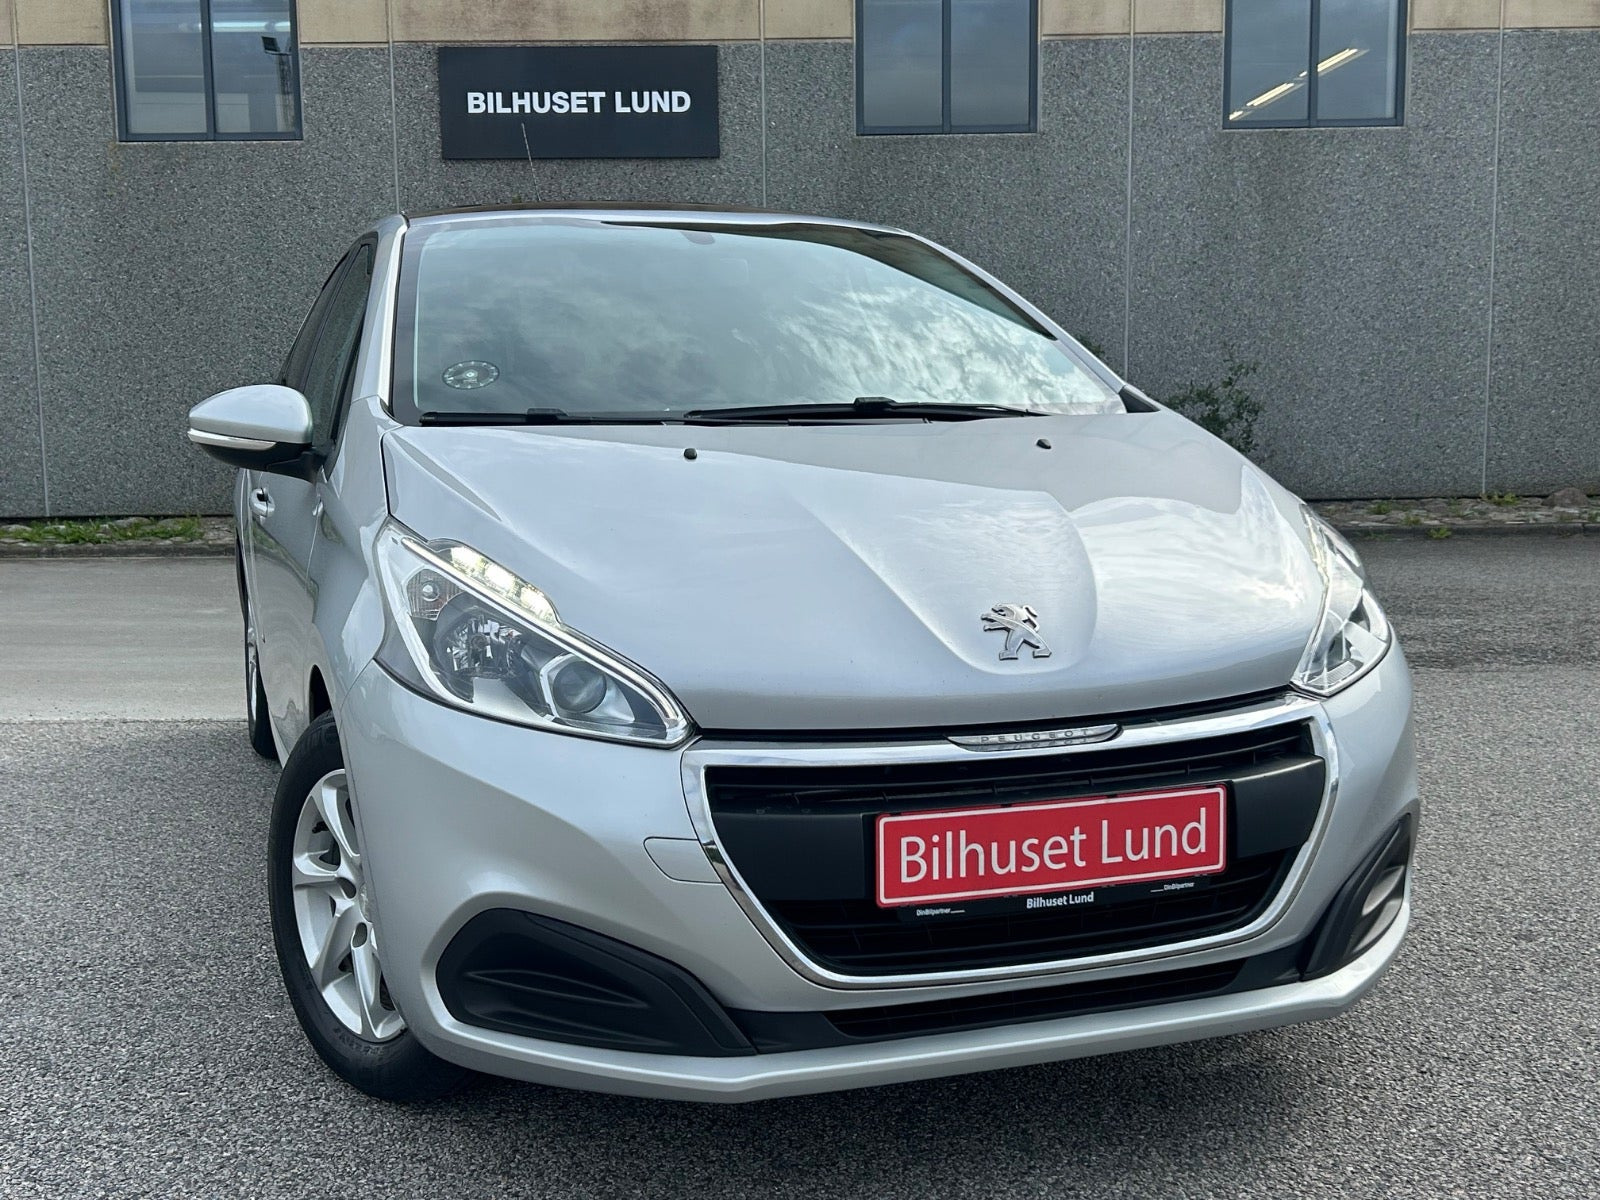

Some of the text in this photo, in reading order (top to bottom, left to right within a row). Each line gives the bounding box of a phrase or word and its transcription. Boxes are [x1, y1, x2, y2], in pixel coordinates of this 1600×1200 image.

[467, 91, 691, 113] BILHUSET LUND
[980, 728, 1090, 744] PEUGEOT
[900, 807, 1207, 884] Bilhuset Lund
[1026, 891, 1095, 910] Bilhuset Lund
